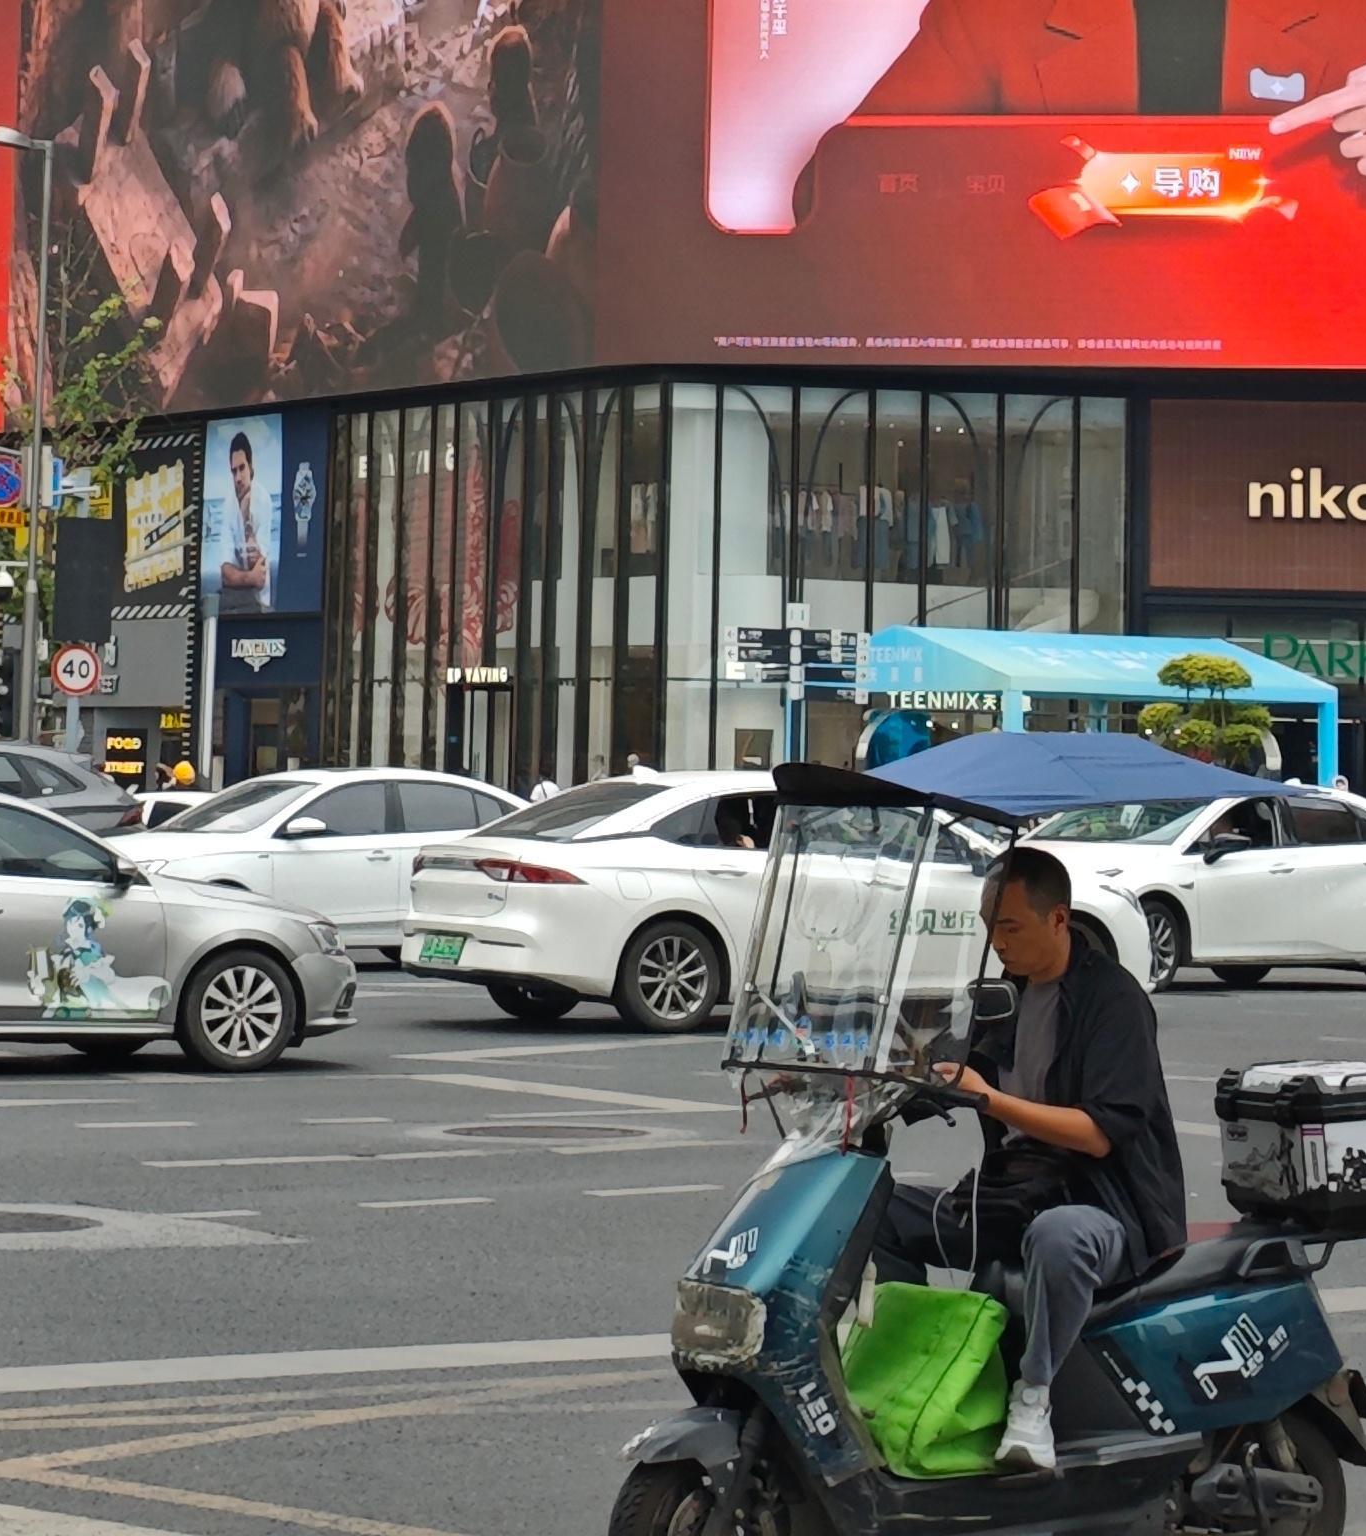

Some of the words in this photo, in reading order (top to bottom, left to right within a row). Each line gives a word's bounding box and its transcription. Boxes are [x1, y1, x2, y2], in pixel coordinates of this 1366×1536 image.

[1150, 167, 1221, 198] 导购
[231, 638, 287, 657] LONGINES
[62, 659, 91, 679] 40
[887, 691, 980, 711] TEENMIX
[106, 736, 142, 750] FOOD
[798, 1381, 837, 1436] LEO
